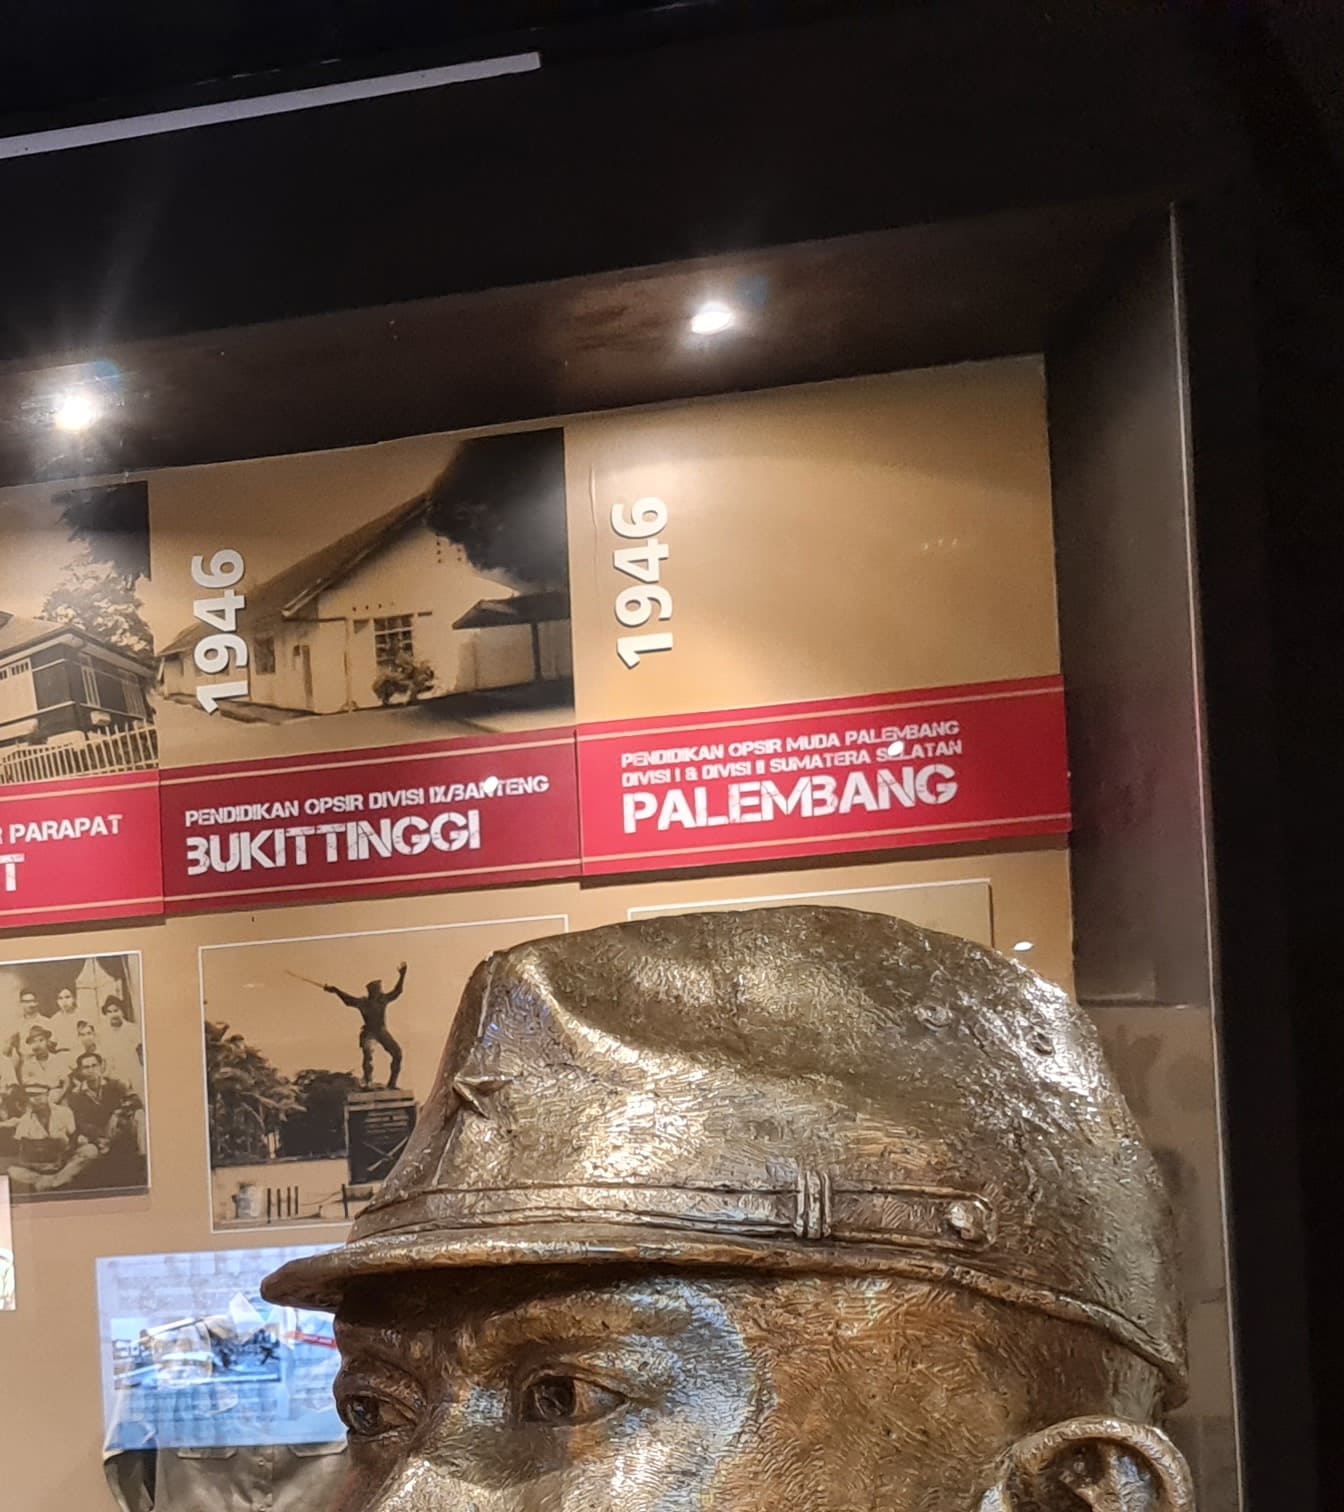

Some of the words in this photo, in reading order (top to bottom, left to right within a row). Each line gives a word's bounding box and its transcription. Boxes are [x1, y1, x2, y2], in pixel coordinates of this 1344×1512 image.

[611, 497, 673, 669] 1946
[191, 549, 248, 714] 1946
[621, 744, 724, 768] PENDIDIKAN
[728, 738, 782, 757] OPSIR
[786, 733, 840, 752] MUDA
[845, 720, 960, 746] PALEMBANG
[622, 768, 671, 787] DIVISI
[675, 767, 681, 782] I
[686, 767, 698, 781] &
[702, 761, 751, 780] DIVISI
[770, 750, 871, 773] SUMATERA
[185, 800, 299, 827] PENDIDIKAN
[305, 793, 364, 815] OPSIR
[369, 788, 424, 809] DIVISI
[623, 764, 958, 834] PALEMBANG
[10, 814, 123, 844] PARAPAT
[187, 809, 480, 875] BUKITTINGGI
